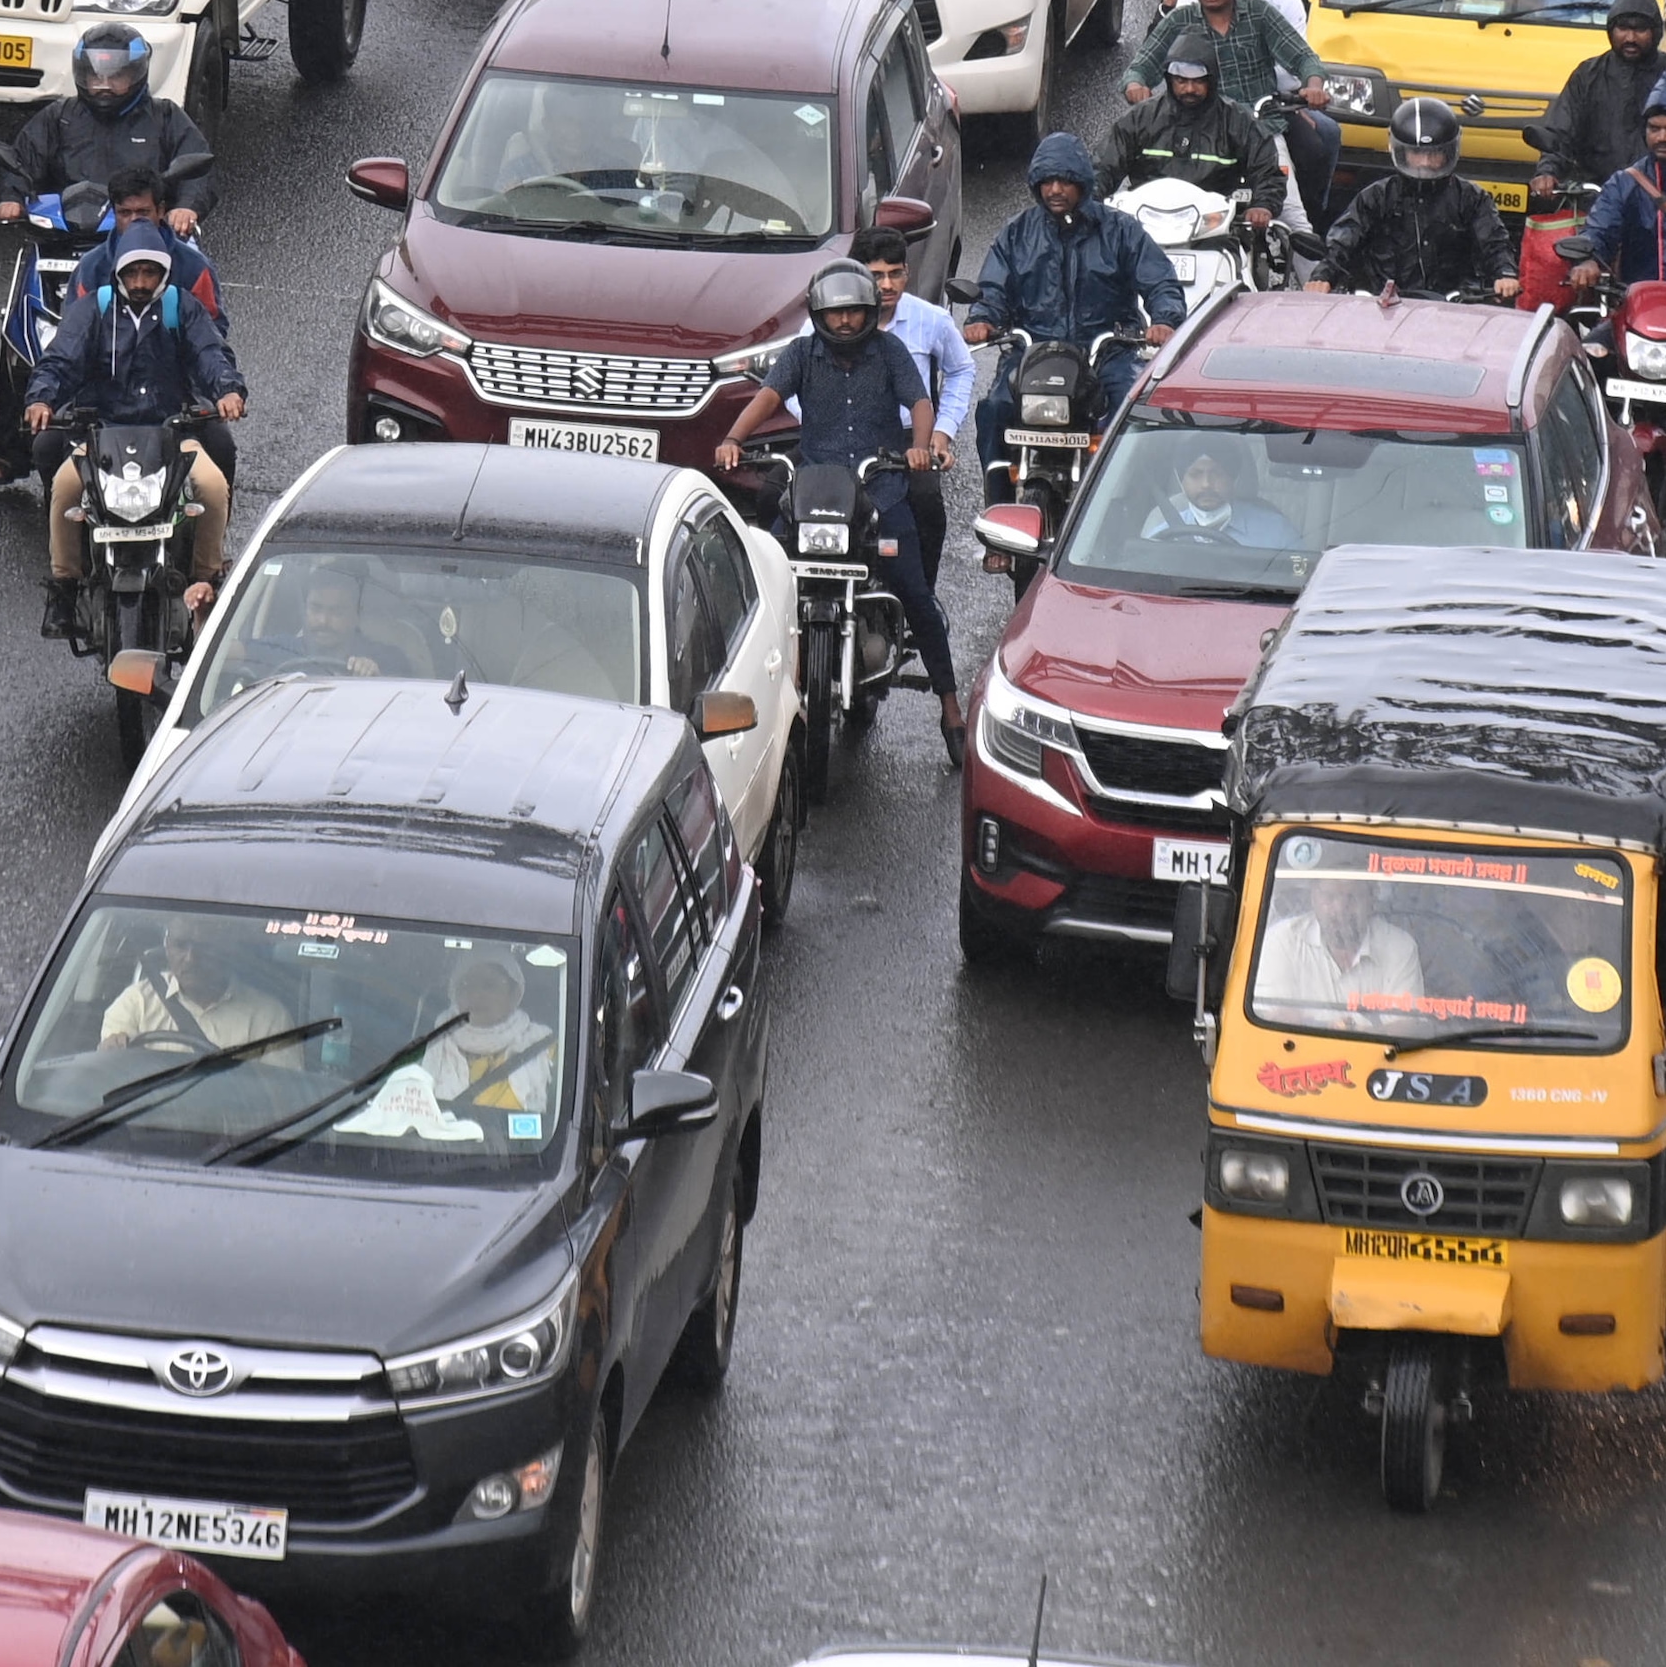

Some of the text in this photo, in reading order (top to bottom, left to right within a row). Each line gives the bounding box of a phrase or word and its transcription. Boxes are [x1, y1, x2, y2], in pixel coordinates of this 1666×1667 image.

[524, 428, 654, 460] MH43BU2562
[1427, 856, 1475, 878] भवानी
[1256, 1060, 1357, 1099] चैतन्य
[1509, 1087, 1547, 1103] 1360
[104, 1503, 282, 1548] MH12NE5346
